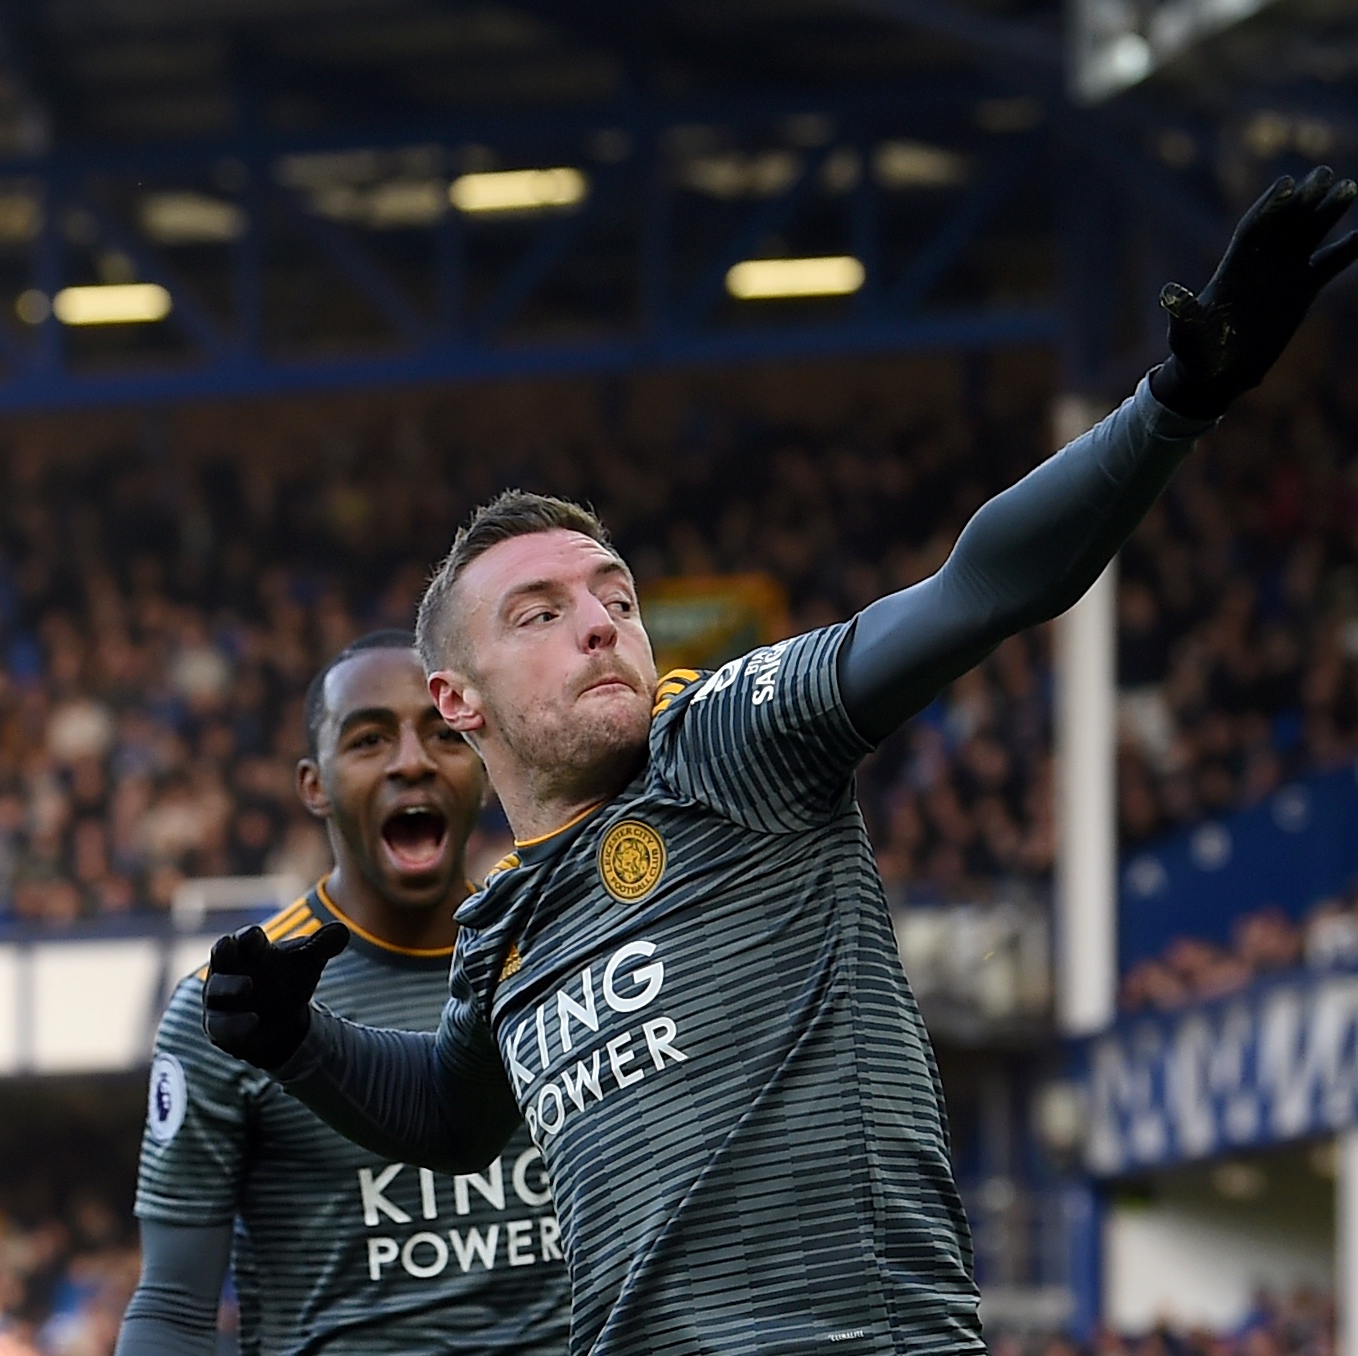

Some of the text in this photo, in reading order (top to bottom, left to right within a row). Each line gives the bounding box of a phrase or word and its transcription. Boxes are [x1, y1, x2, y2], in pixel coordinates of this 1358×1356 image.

[744, 651, 767, 677] BIA
[752, 639, 792, 706] SAIGO
[604, 827, 654, 874] LEICESTER CITY
[610, 876, 653, 894] FOOTBALL
[506, 940, 664, 1100] KING
[525, 1016, 689, 1146] POWER
[358, 1147, 552, 1227] KING
[367, 1216, 564, 1281] POWER
